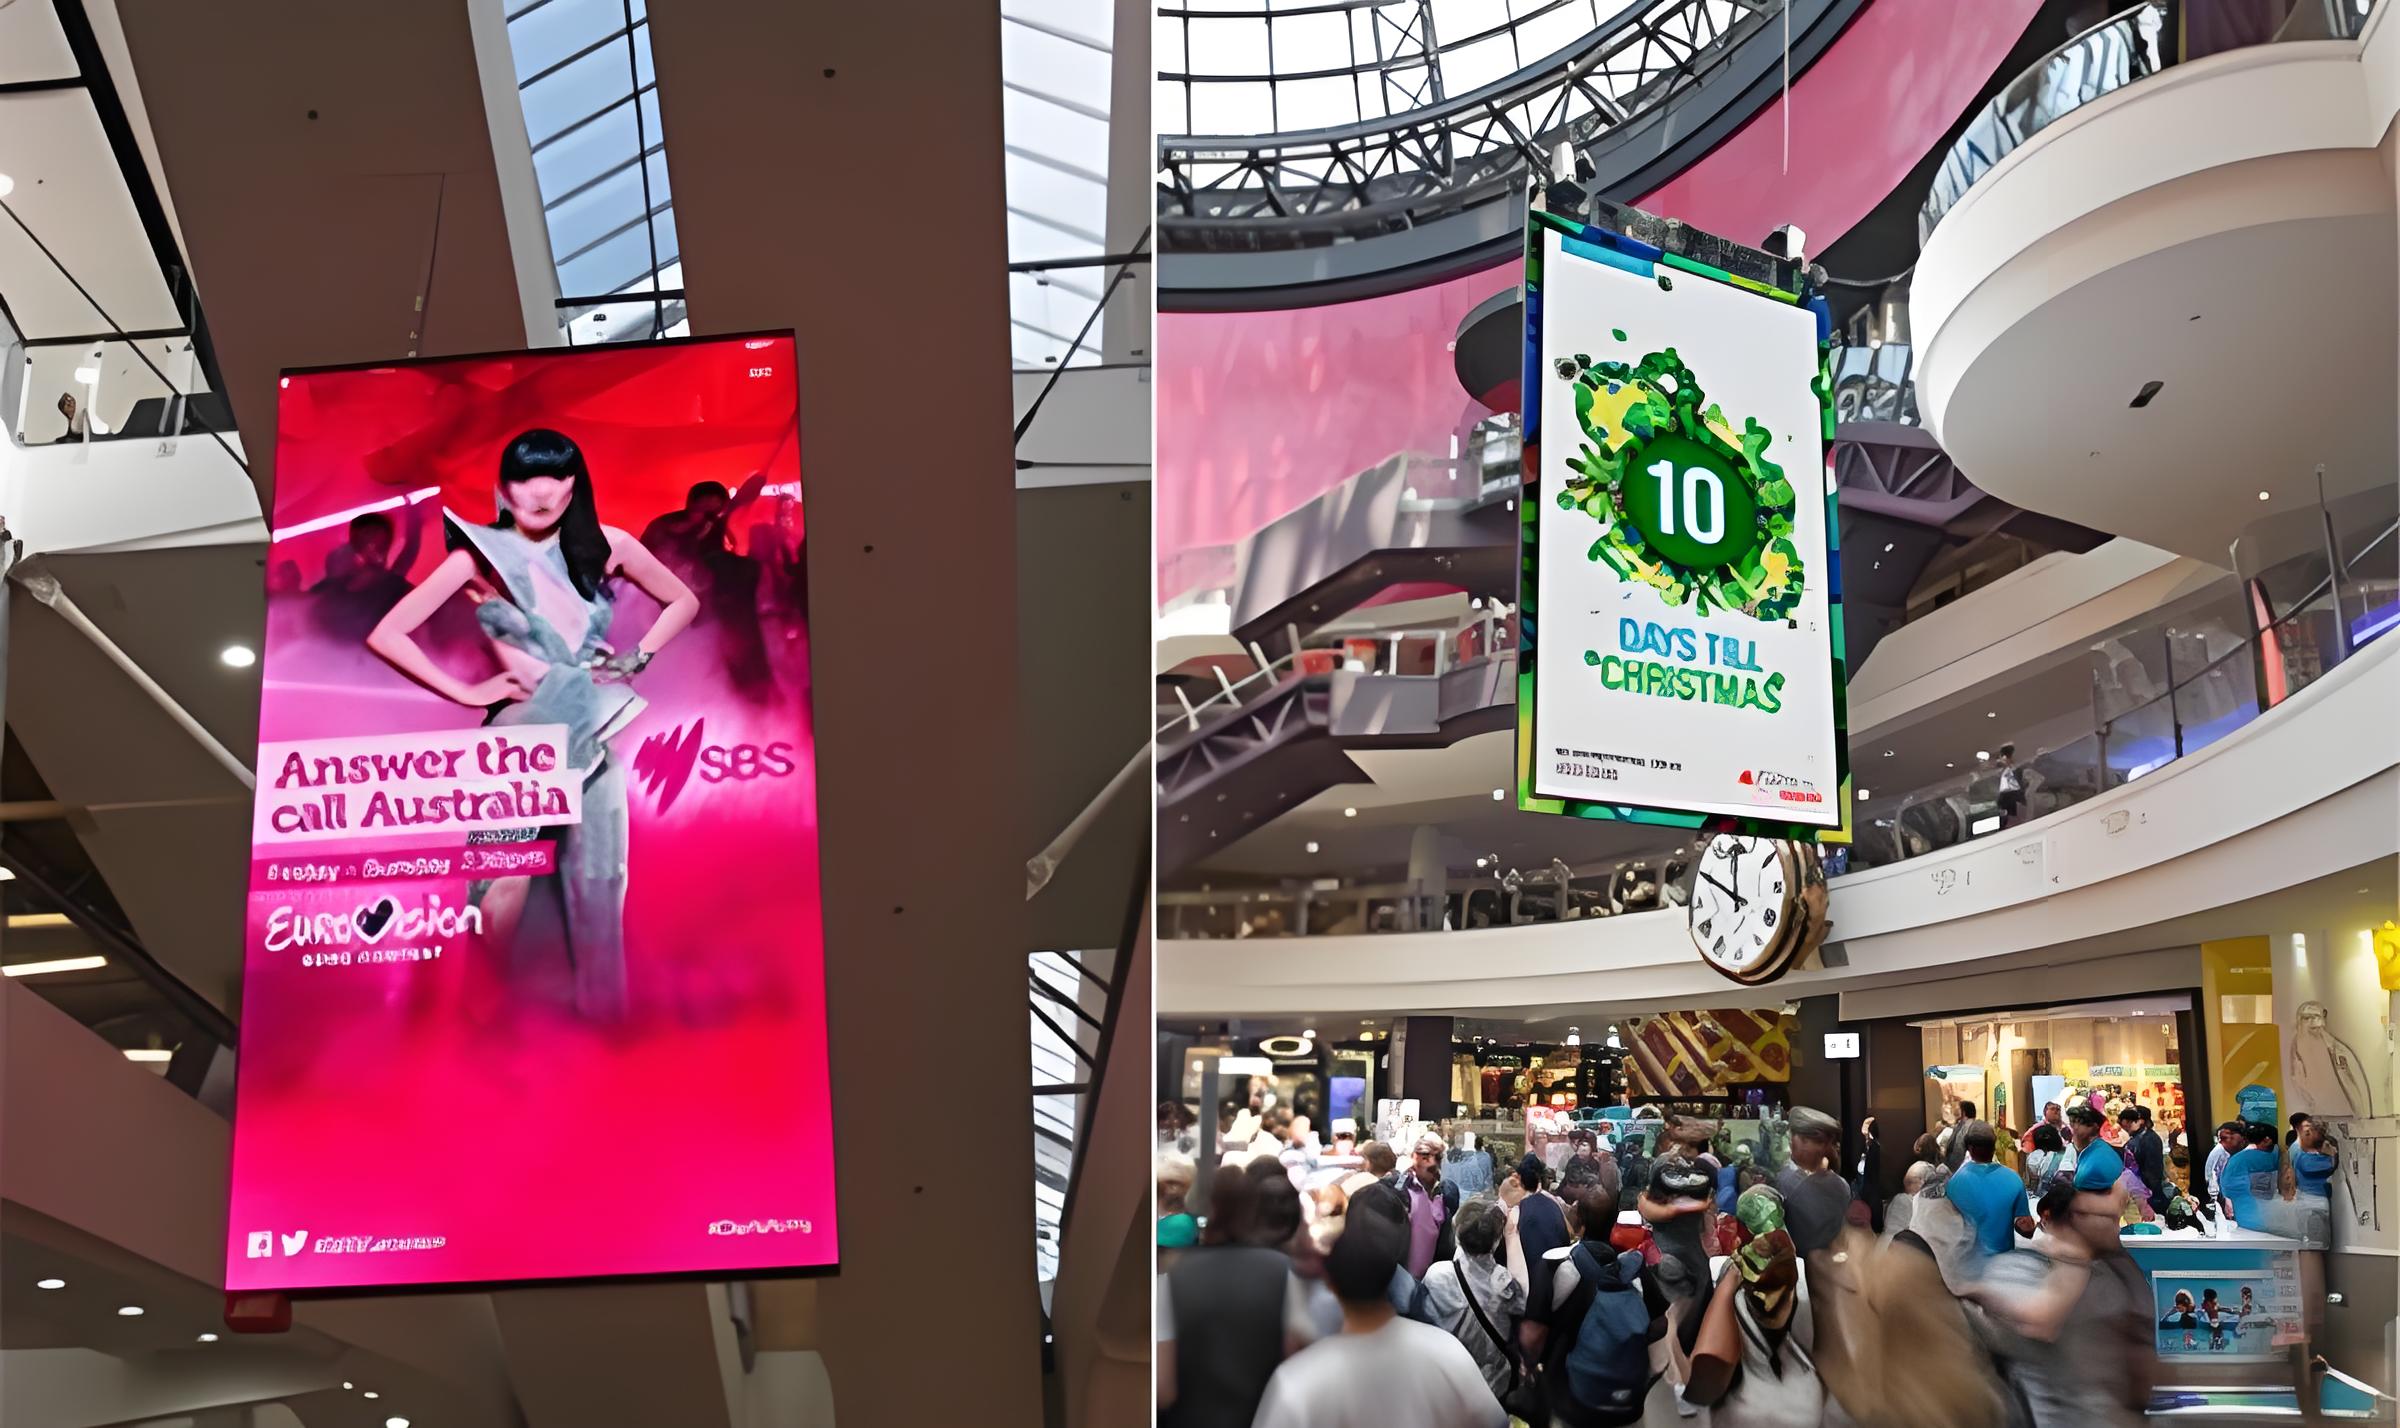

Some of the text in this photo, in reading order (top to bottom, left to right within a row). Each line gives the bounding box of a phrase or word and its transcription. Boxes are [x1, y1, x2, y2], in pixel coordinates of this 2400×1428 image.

[1646, 458, 1726, 545] 10
[1618, 617, 1697, 662] DAYS
[1600, 655, 1787, 714] CHRISTMAS
[274, 736, 556, 789] Answer the
[272, 780, 572, 834] call Australia
